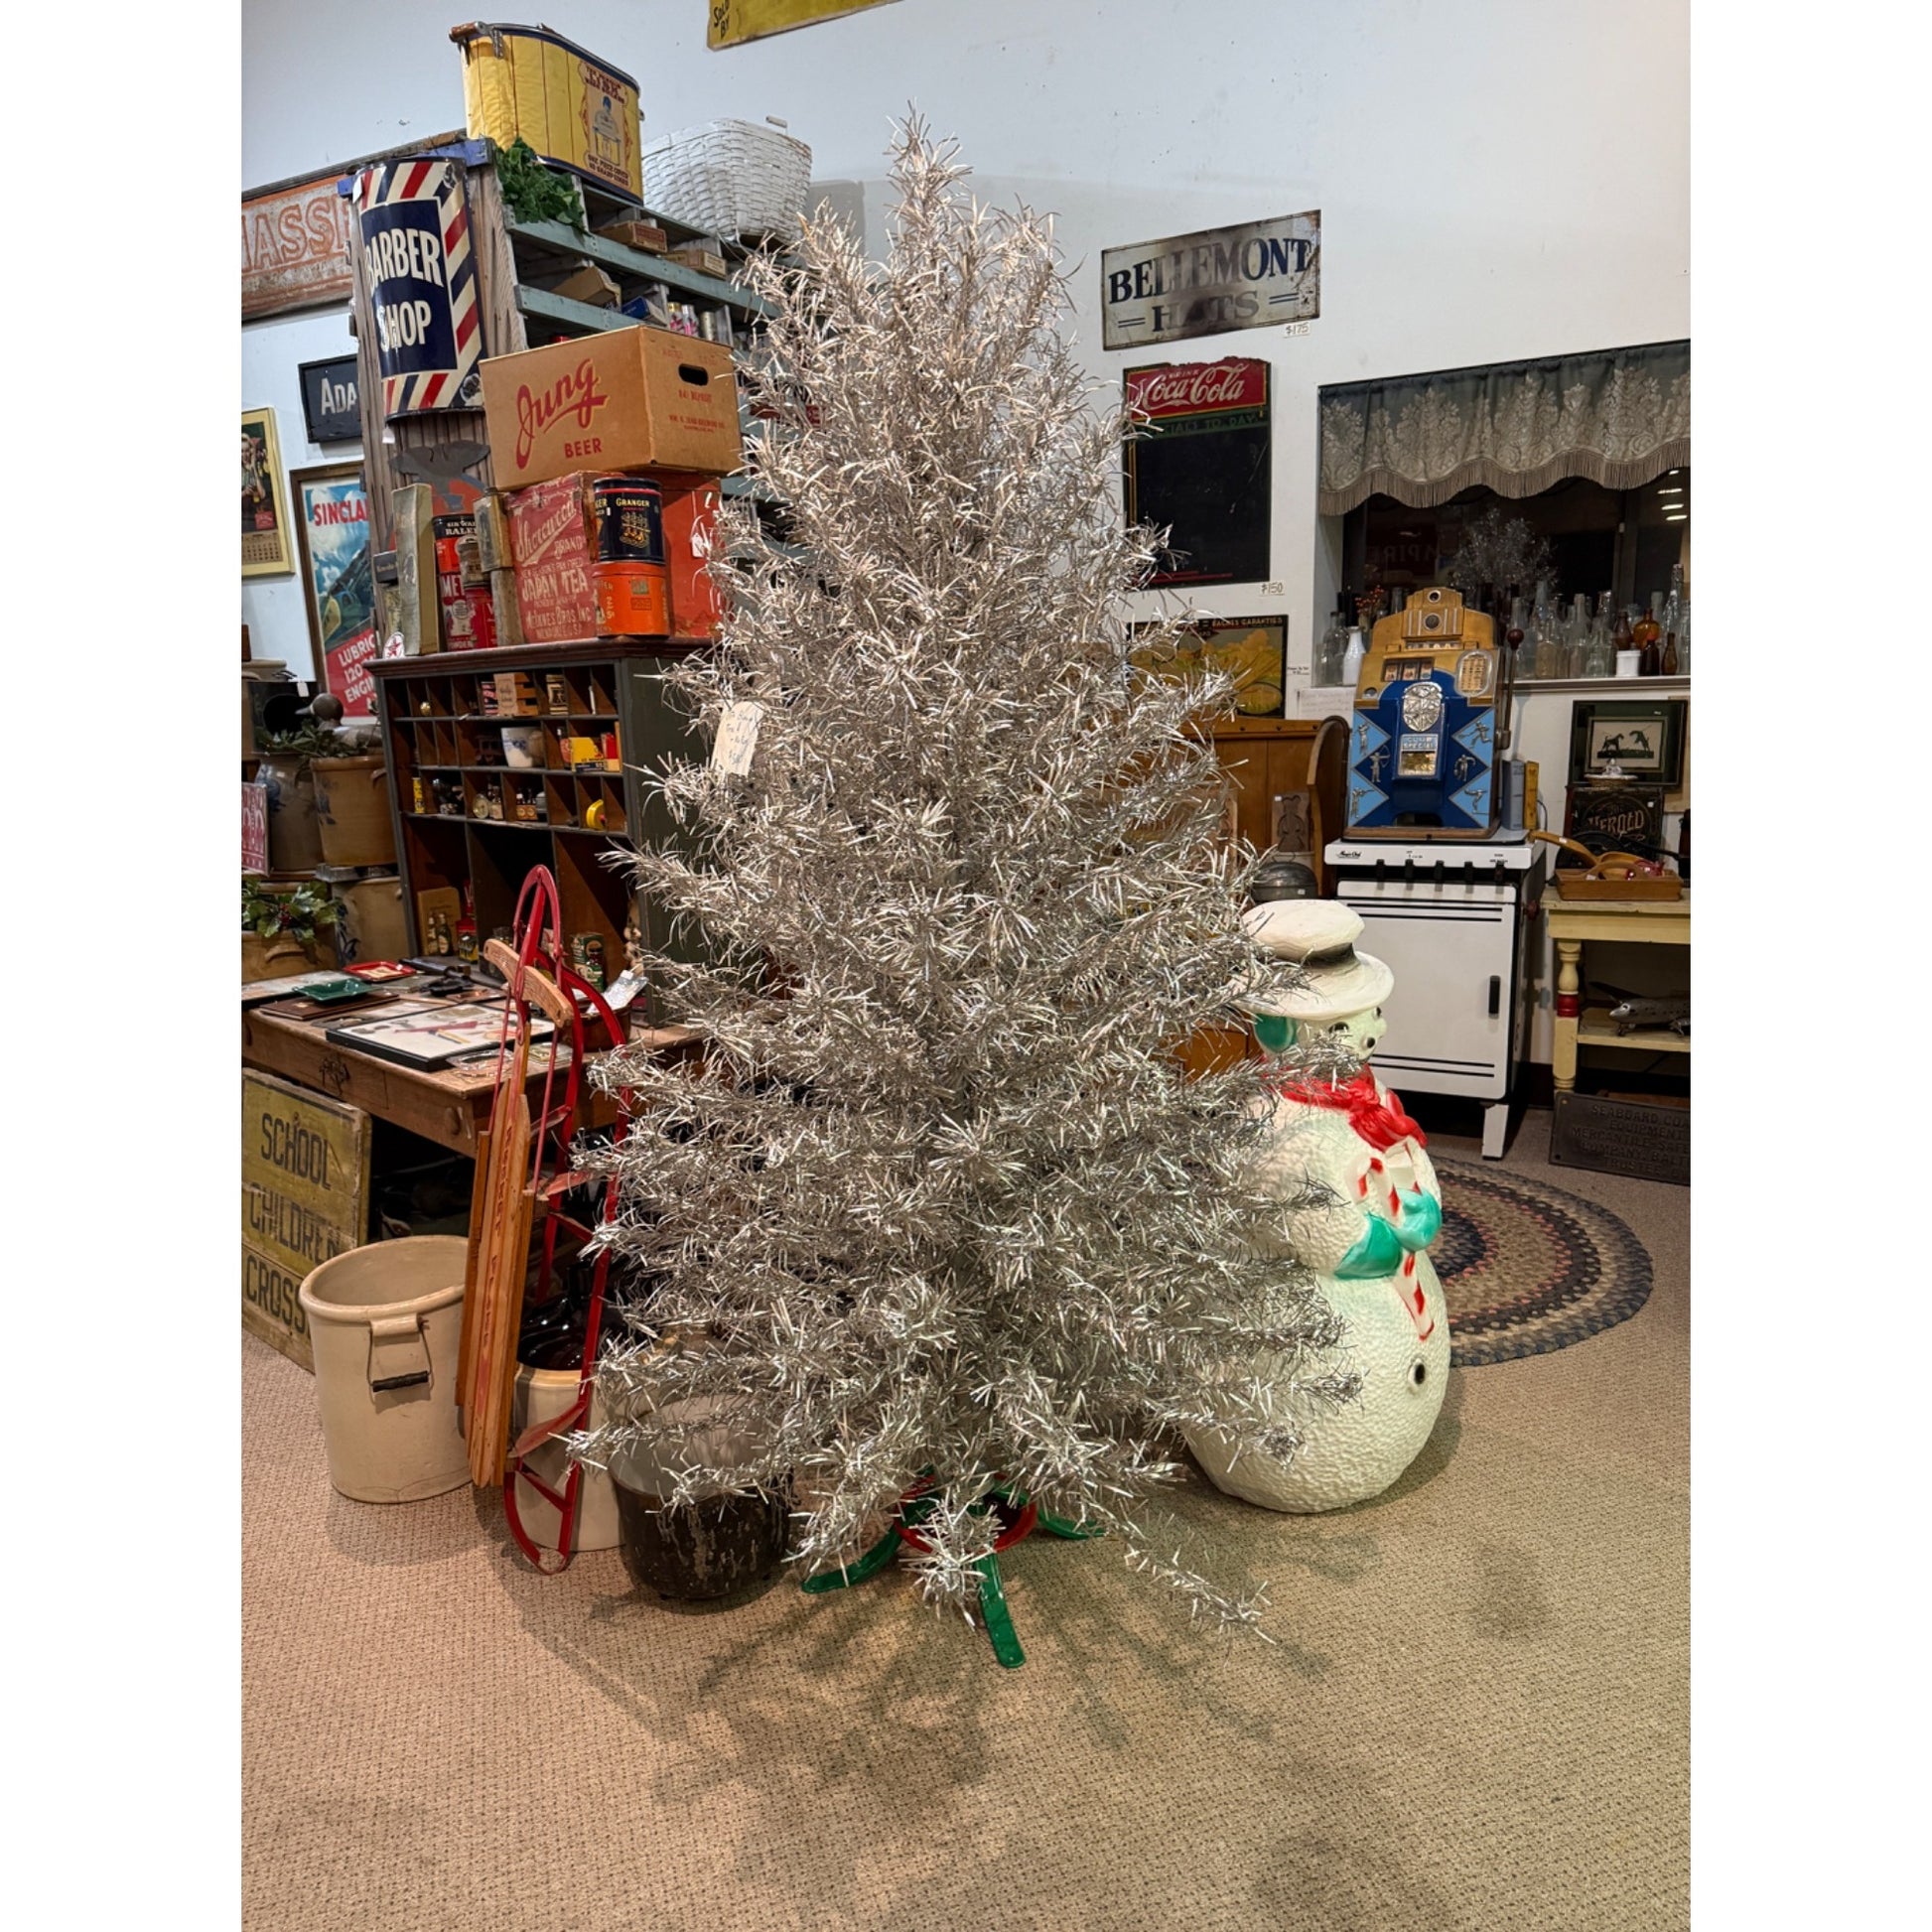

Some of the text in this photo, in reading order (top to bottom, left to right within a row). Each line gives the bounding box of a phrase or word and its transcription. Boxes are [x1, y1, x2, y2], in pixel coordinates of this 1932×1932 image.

[720, 16, 730, 40] BY
[365, 227, 445, 297] BARBER
[1108, 237, 1312, 305] BELLEMONT
[376, 300, 432, 352] SHOP
[1152, 290, 1259, 333] HATS
[1285, 324, 1310, 336] $175
[1142, 363, 1250, 411] Coca-Cola
[516, 357, 609, 470] Jung
[564, 437, 603, 459] BEER
[616, 497, 650, 507] GRANGER
[522, 574, 559, 603] JAPAN
[561, 569, 589, 595] TEA
[1261, 582, 1284, 595] $150
[344, 663, 363, 684] 120
[260, 1112, 332, 1190] SCHOOL
[246, 1255, 311, 1339] CROSS
